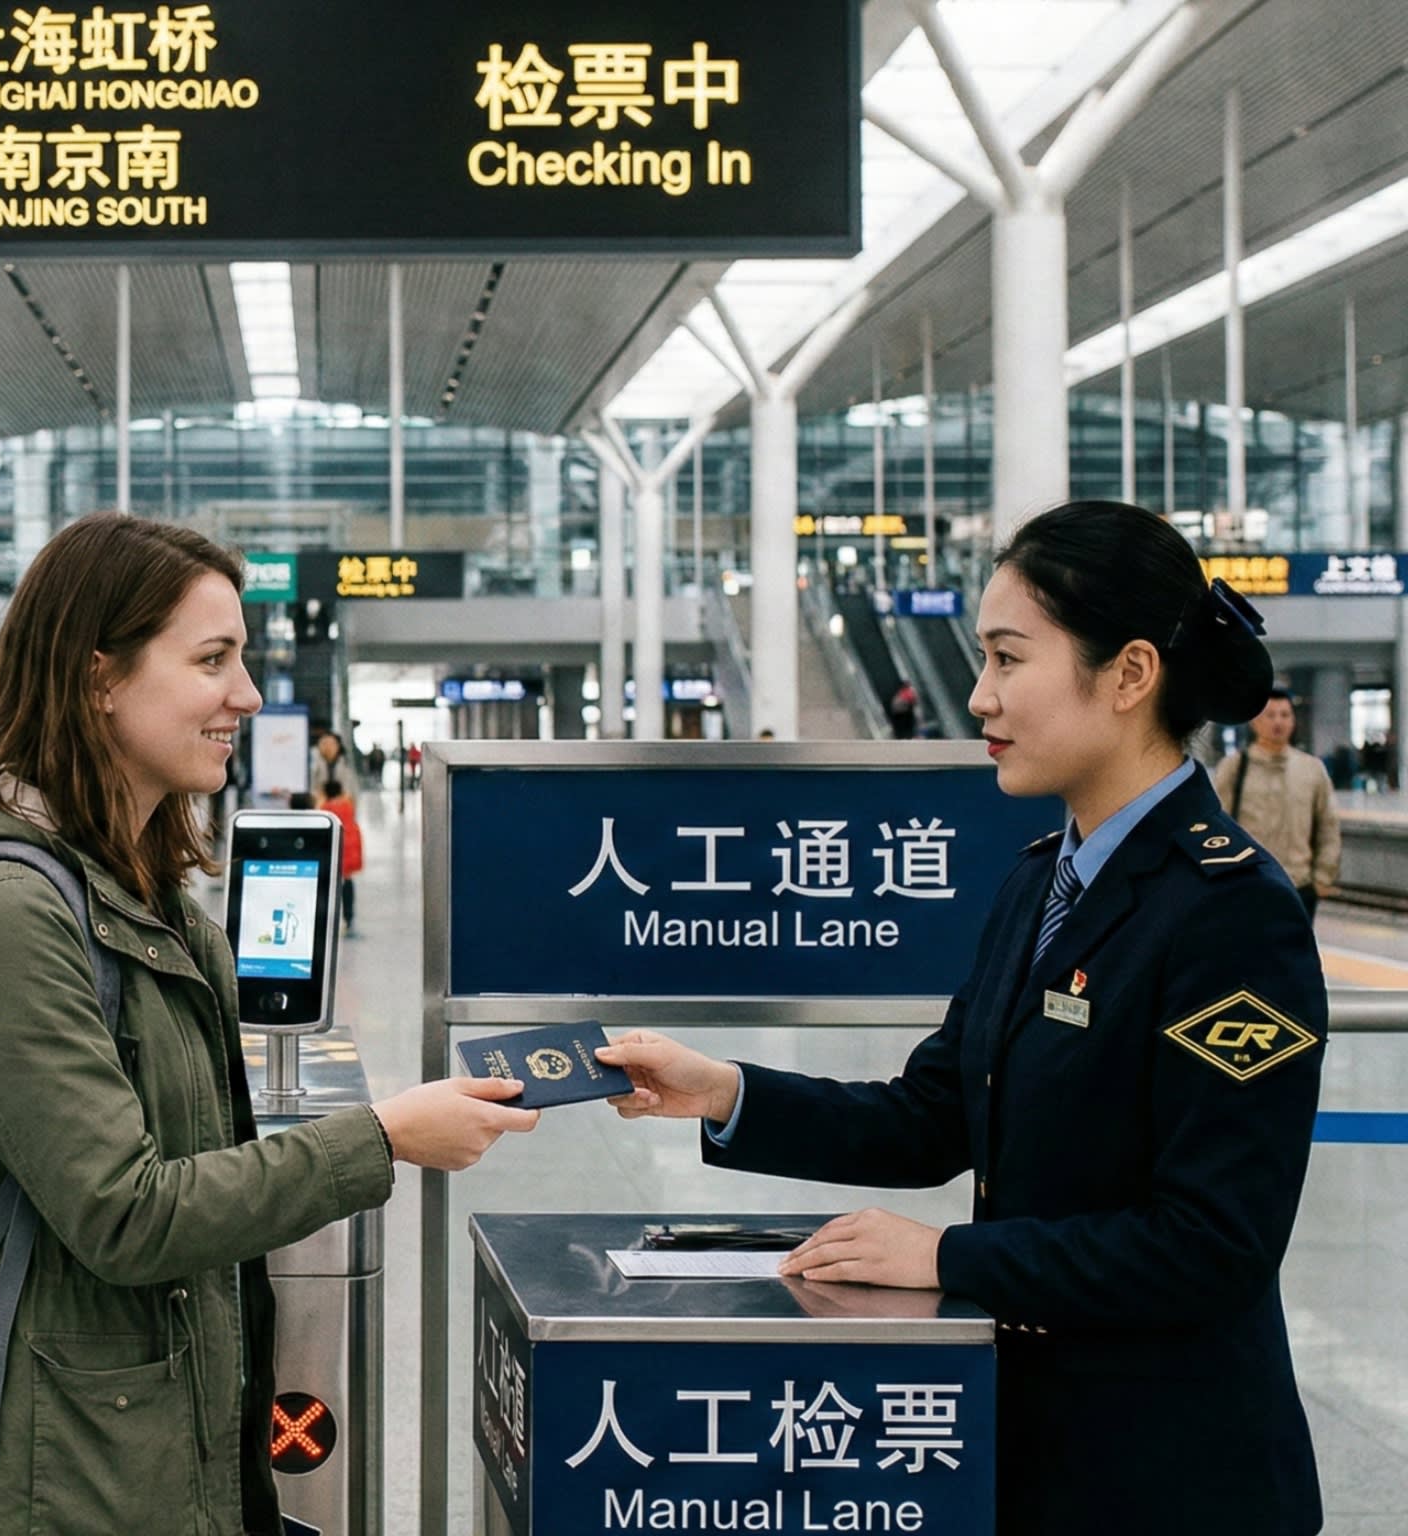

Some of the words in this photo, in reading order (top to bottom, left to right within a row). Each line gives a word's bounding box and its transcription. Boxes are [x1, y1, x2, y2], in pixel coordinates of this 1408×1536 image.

[84, 79, 258, 109] HONGQIAO
[475, 42, 739, 130] 检票中
[468, 141, 691, 195] Checking
[708, 141, 751, 184] In
[97, 196, 206, 226] SOUTH
[568, 817, 956, 898] 人工通道
[625, 910, 778, 947] Manual
[795, 911, 899, 947] Lane
[1206, 1021, 1279, 1049] CR
[565, 1380, 963, 1473] 人工检票
[605, 1489, 782, 1531] Manual
[804, 1491, 923, 1531] Lane
